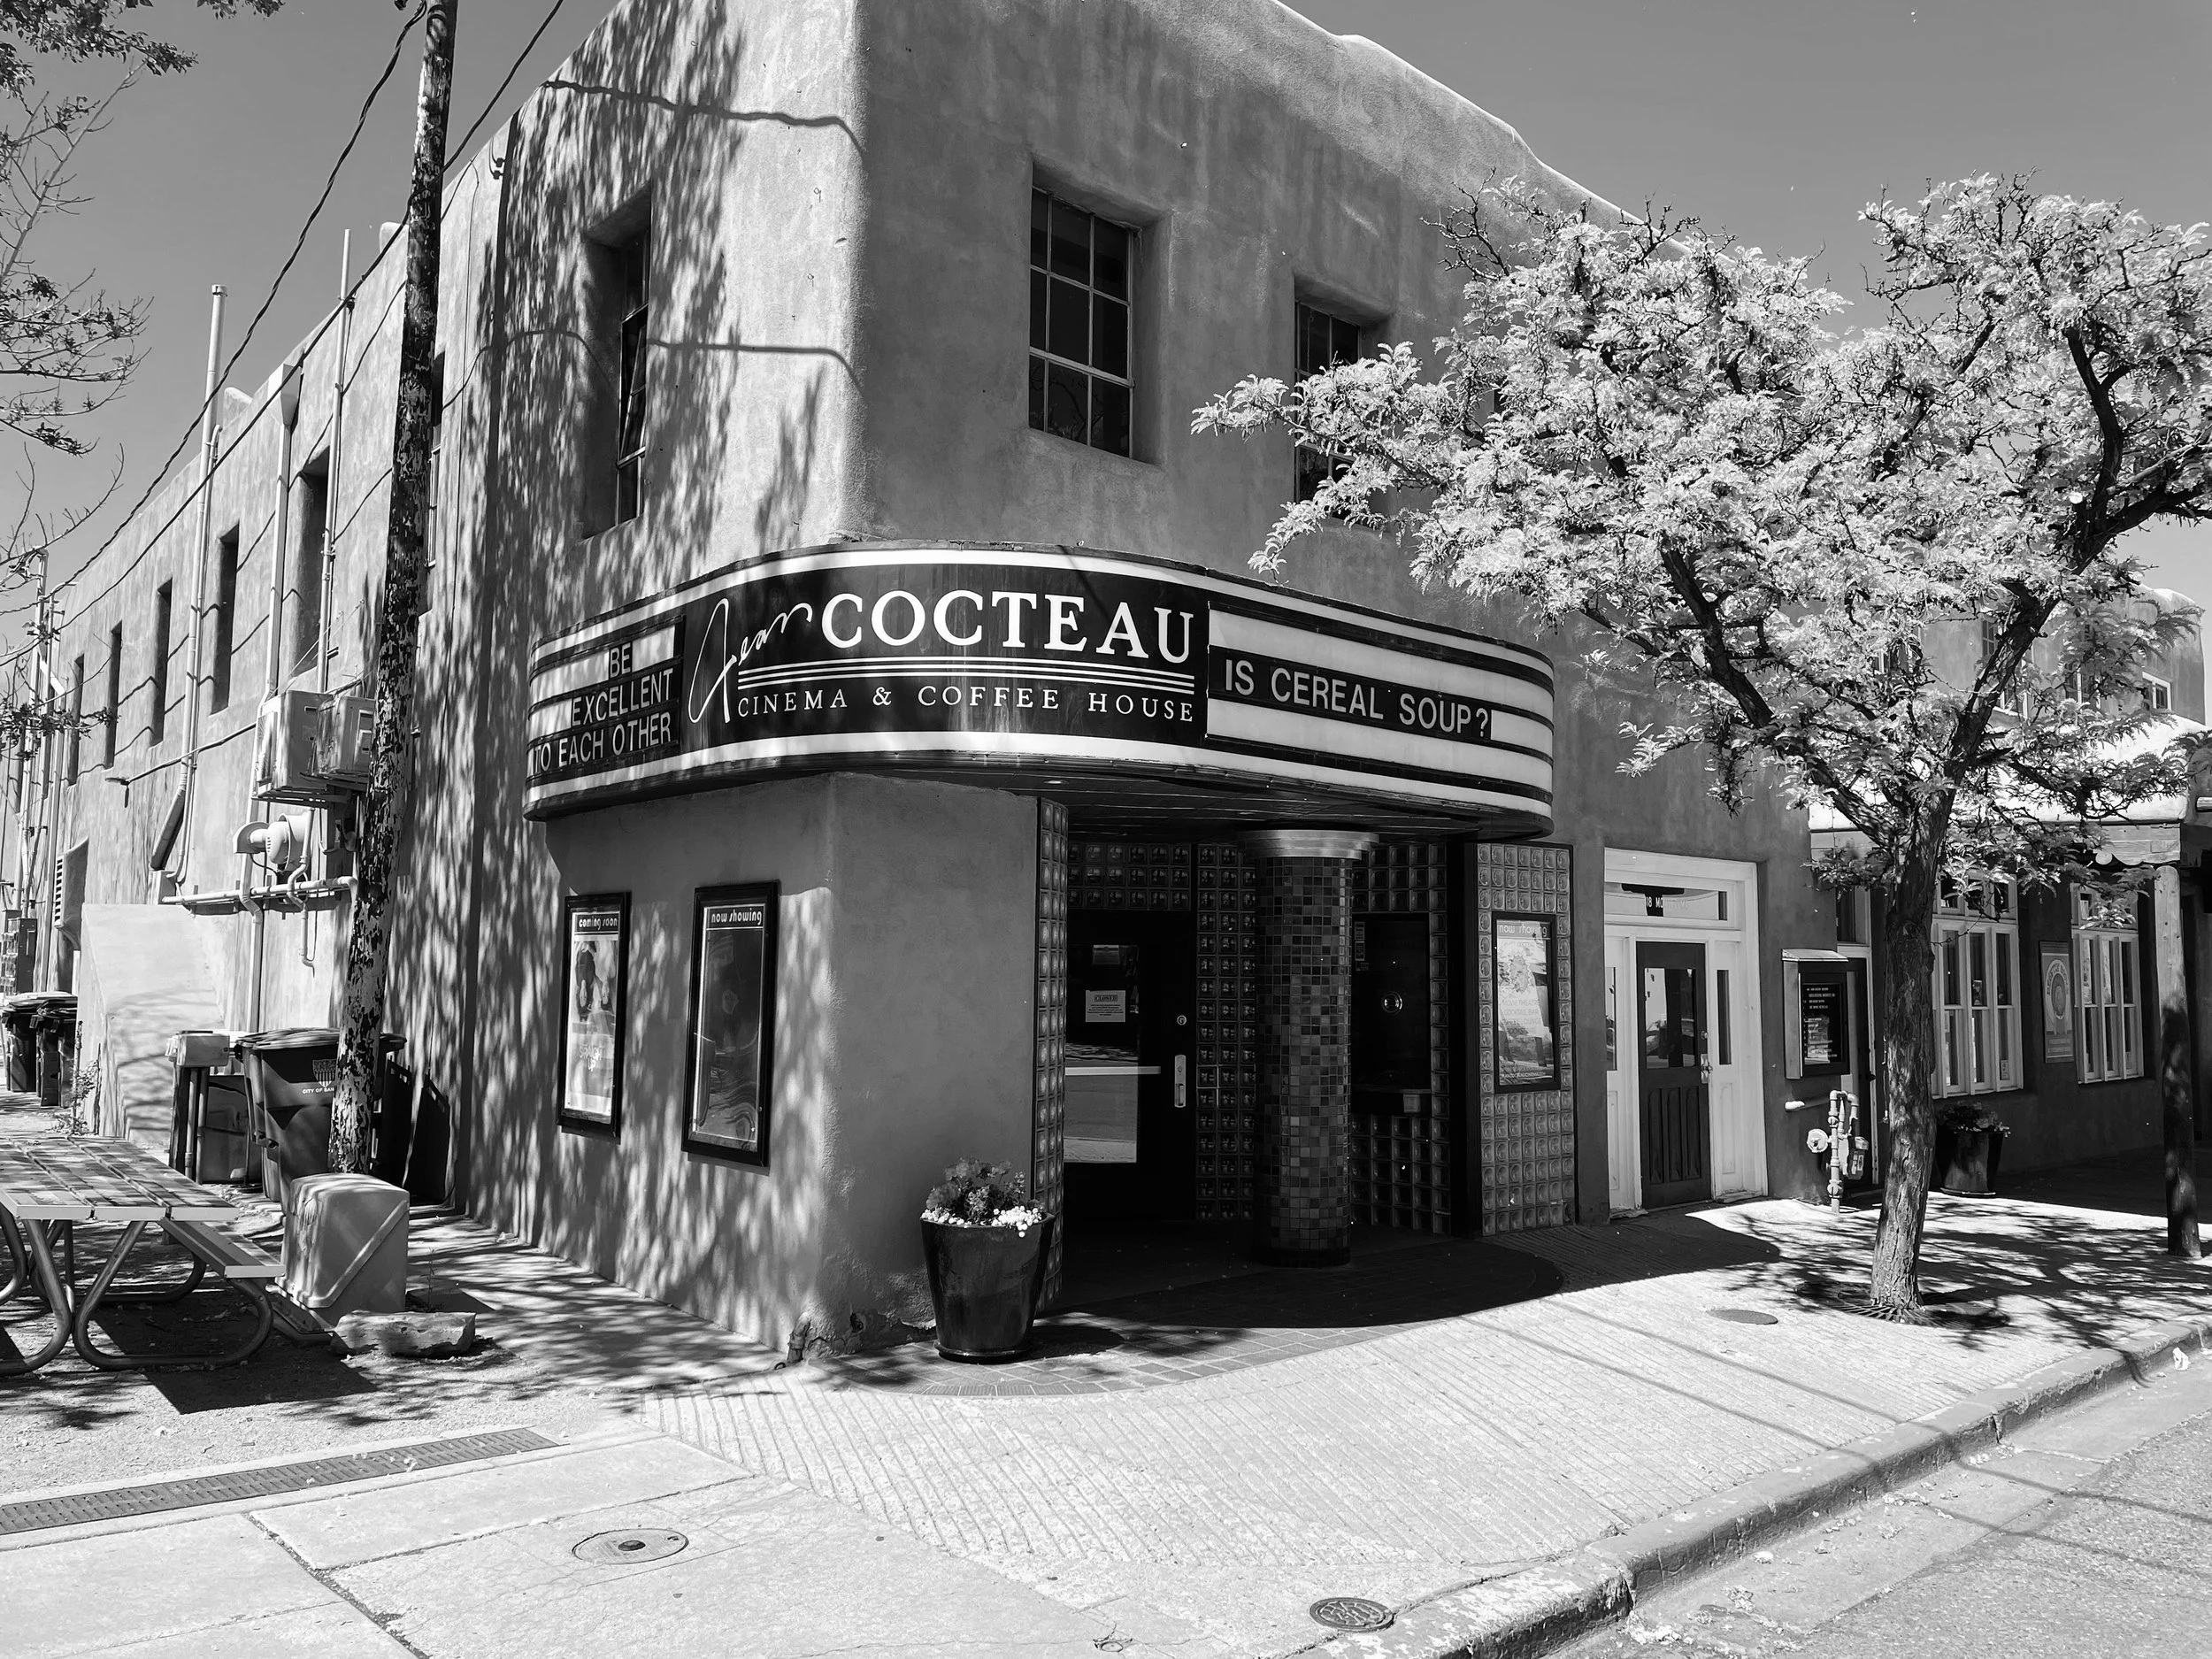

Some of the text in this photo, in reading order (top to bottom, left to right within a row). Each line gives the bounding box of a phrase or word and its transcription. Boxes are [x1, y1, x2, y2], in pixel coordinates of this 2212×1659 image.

[821, 589, 1194, 664] COCTEAU
[610, 641, 631, 678] BE
[572, 668, 673, 726] EXCELLENT
[738, 685, 1193, 722] CINEMA & COFFEE HOUSE
[1225, 658, 1489, 737] IS CEREAL SOUP?
[534, 711, 672, 773] TO EACH OTHER
[579, 915, 618, 930] coming soon
[710, 907, 762, 926] now showing
